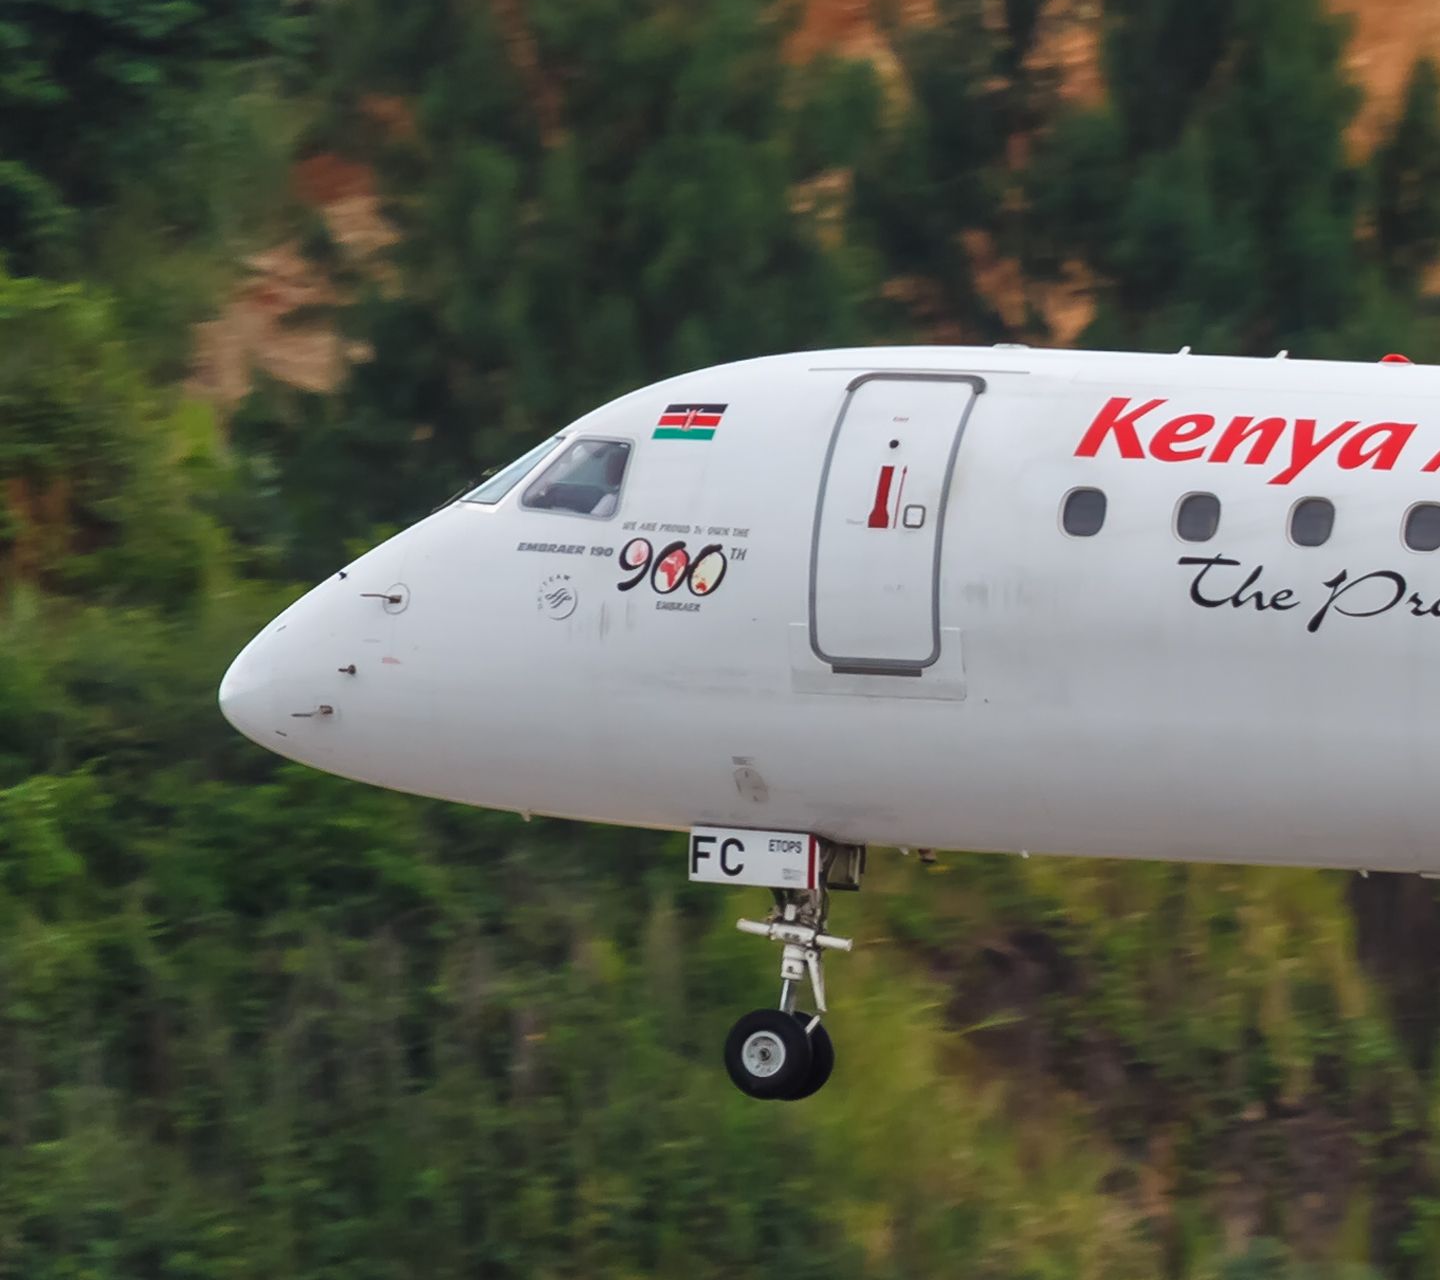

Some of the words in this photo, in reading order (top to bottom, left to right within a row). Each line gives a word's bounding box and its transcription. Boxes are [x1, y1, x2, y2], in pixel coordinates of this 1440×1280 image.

[1074, 397, 1417, 486] Kenya
[517, 542, 585, 556] EMBRAER
[590, 546, 614, 557] 190
[617, 537, 727, 597] 900
[730, 547, 747, 560] TH
[1178, 554, 1300, 611] The
[691, 835, 745, 877] FC
[768, 839, 802, 854] ETOPS
